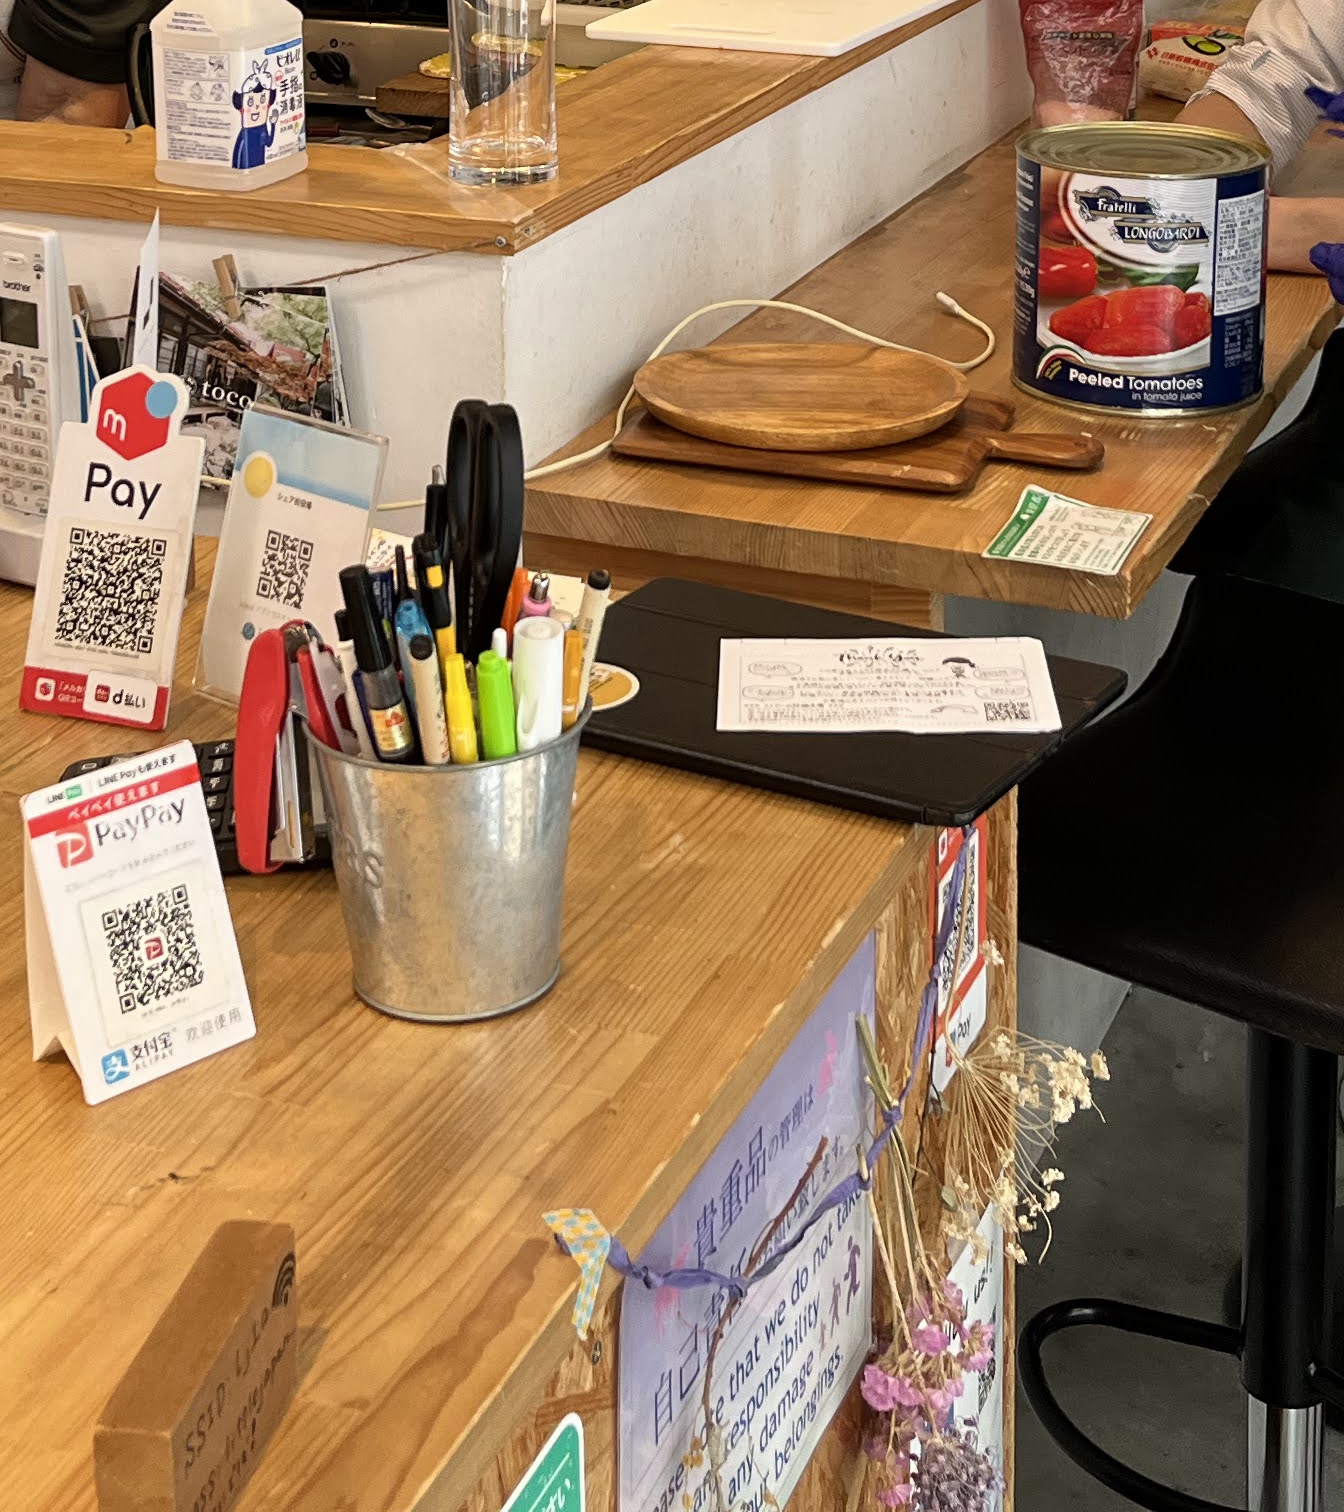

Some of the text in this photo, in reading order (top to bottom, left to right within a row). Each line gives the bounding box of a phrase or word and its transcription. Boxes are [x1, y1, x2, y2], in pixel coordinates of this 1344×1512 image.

[1124, 226, 1200, 240] LONGOBARDI
[1068, 368, 1204, 391] Peeled Tomatoes
[1131, 390, 1203, 403] in tomato juice
[84, 461, 162, 520] Pay
[94, 797, 185, 847] PayPay
[729, 1334, 761, 1402] that
[764, 1300, 786, 1345] we
[791, 1266, 809, 1308] do
[813, 1221, 833, 1275] not
[728, 1348, 815, 1506] any damage
